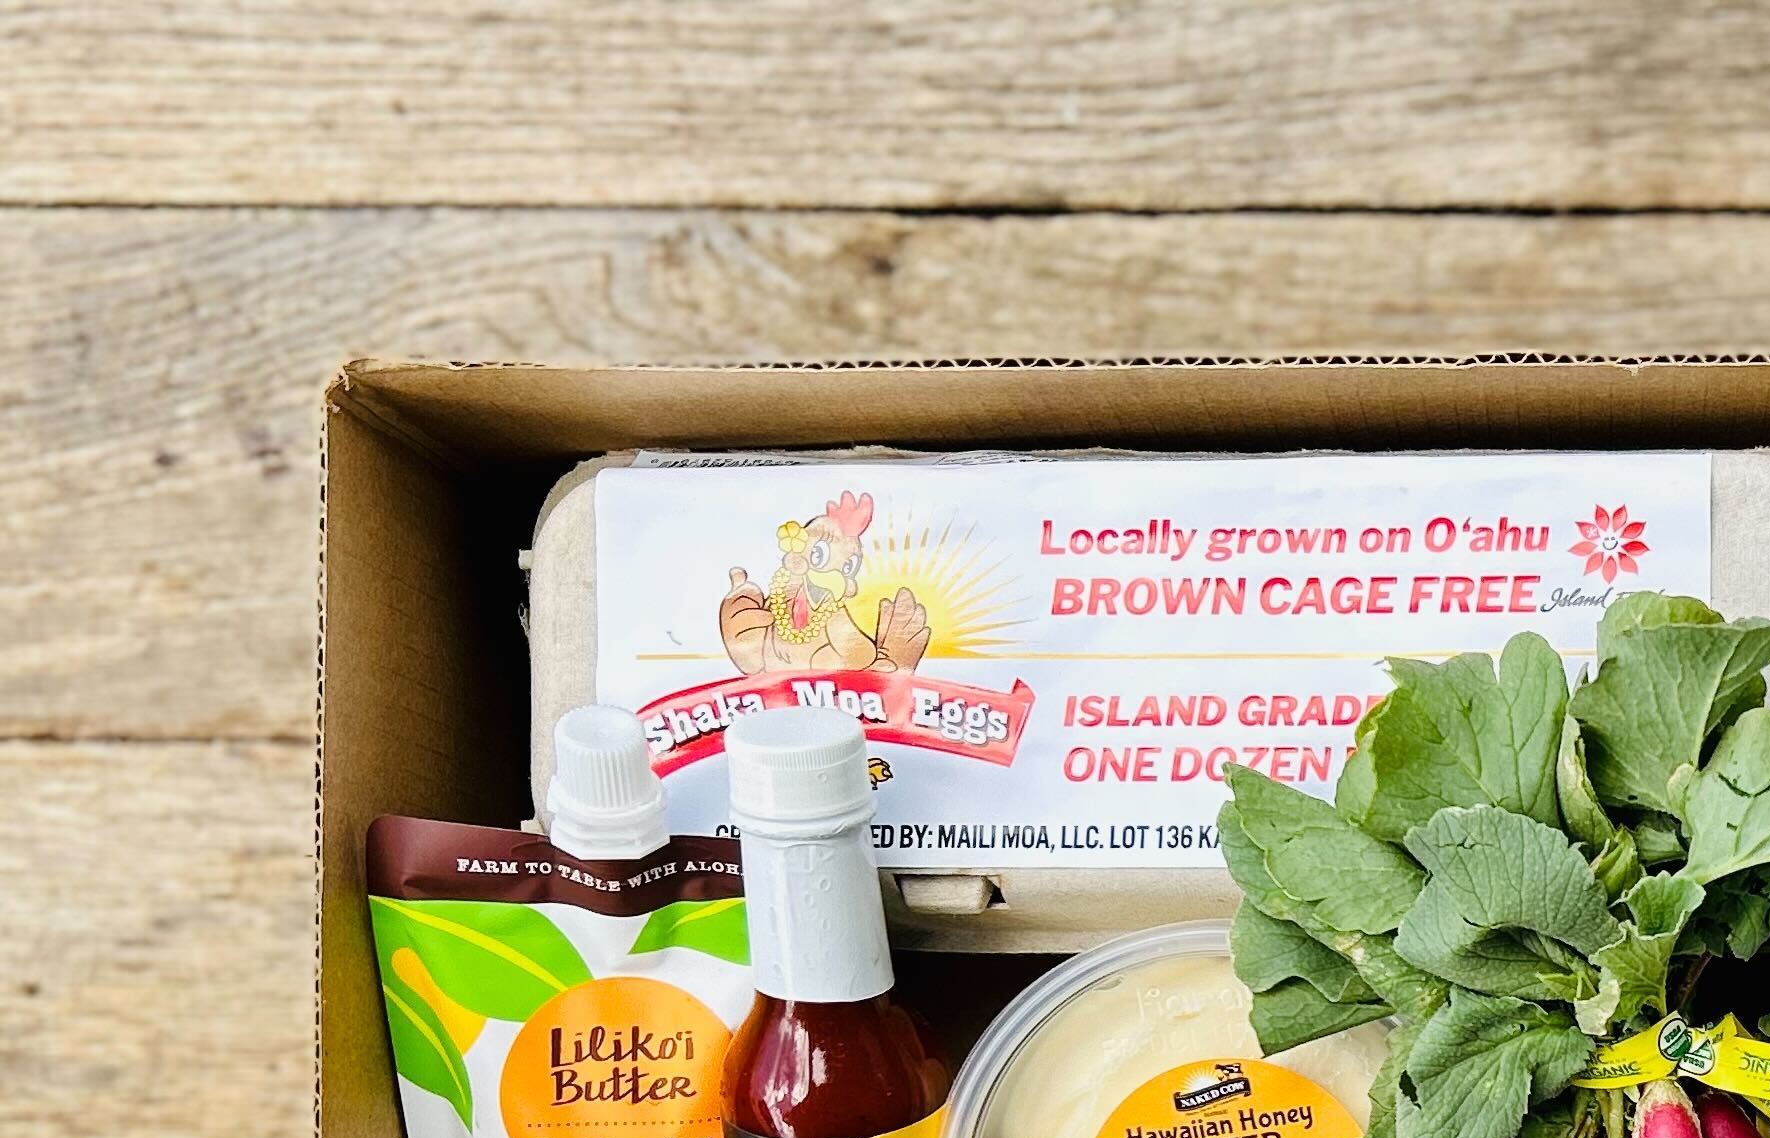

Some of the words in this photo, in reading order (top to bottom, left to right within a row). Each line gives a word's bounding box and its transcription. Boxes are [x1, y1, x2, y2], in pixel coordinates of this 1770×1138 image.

[1040, 518, 1195, 559] Locally
[1205, 526, 1347, 561] grown
[1359, 525, 1410, 553] on
[1051, 577, 1247, 616] BROWN
[1259, 576, 1396, 615] CAGE
[1408, 575, 1540, 613] FREE
[1540, 587, 1614, 613] Island
[645, 690, 766, 754] Shaka
[792, 680, 887, 724] Moa
[912, 689, 1010, 745] Eggs
[1063, 695, 1226, 727] ISLAND
[1063, 746, 1163, 782] ONE
[1172, 746, 1330, 783] DOZEN
[899, 824, 934, 849] BY:
[938, 824, 996, 850] MAILI
[1002, 824, 1054, 852] MOA,
[1061, 825, 1105, 849] LLC.
[1110, 824, 1150, 848] LOT
[1156, 823, 1194, 848] 136
[457, 859, 519, 875] FARM
[525, 860, 551, 875] TO
[558, 865, 622, 892] TABLE
[627, 864, 678, 889] WITH
[550, 1066, 697, 1107] Butter
[1179, 1087, 1218, 1108] NAKED
[1219, 1079, 1246, 1096] COW
[1239, 1106, 1313, 1130] Honey
